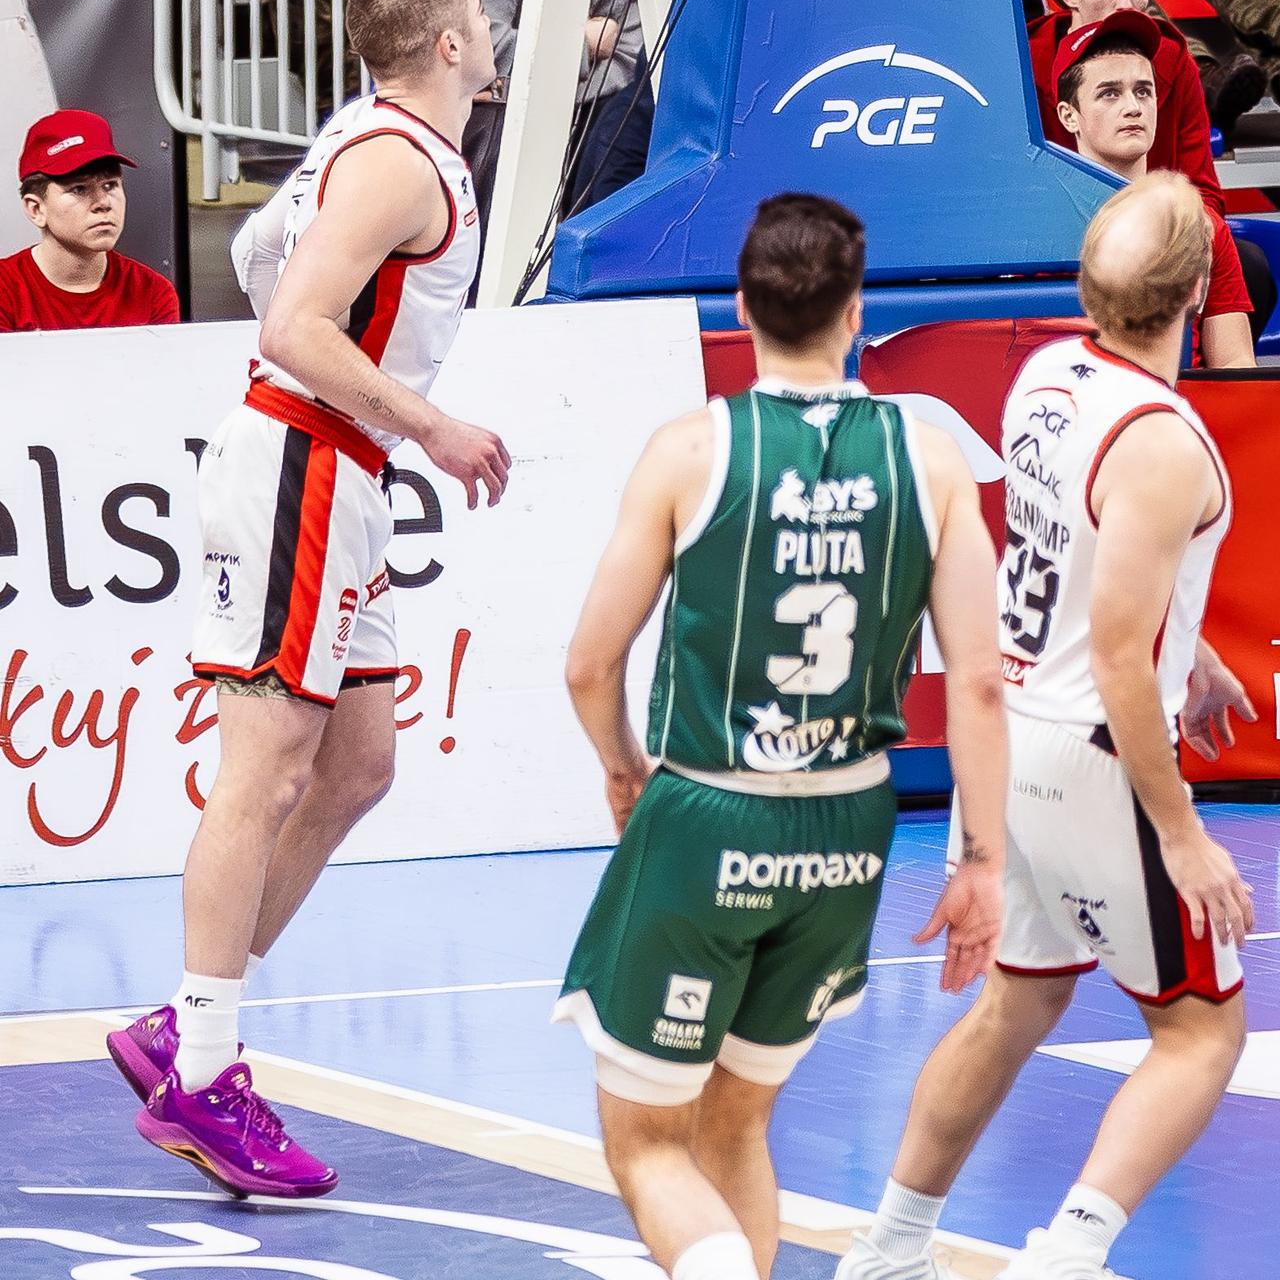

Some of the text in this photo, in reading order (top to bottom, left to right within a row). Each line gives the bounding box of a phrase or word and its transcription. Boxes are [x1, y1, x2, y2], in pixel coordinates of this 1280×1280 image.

[811, 96, 944, 149] PGE
[774, 529, 866, 576] PLUTA
[765, 581, 860, 696] 3
[718, 849, 867, 893] pompax
[714, 889, 774, 910] SERWIS
